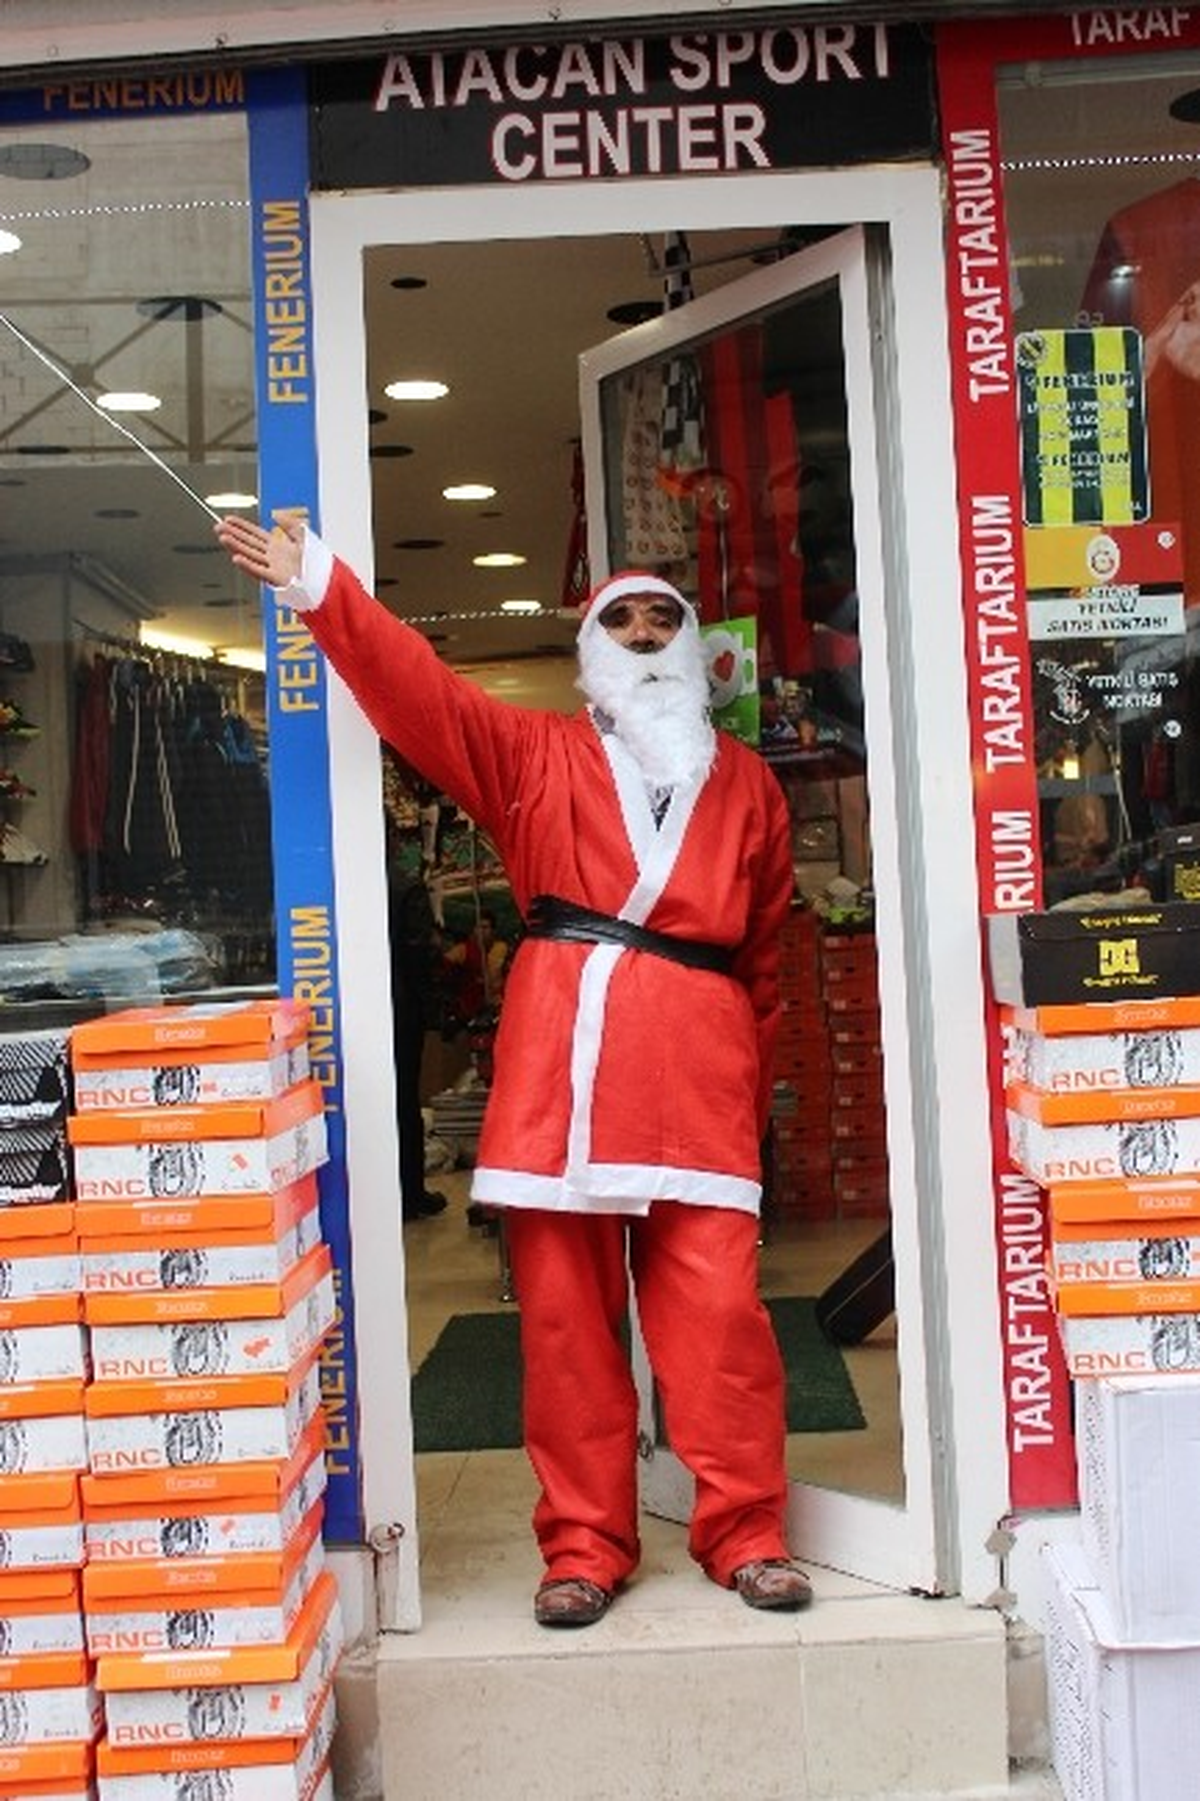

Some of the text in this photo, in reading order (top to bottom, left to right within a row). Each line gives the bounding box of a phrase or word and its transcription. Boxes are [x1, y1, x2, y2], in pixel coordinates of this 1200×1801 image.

[374, 21, 890, 112] ATACAN SPORT
[490, 102, 772, 181] CENTER
[950, 129, 1010, 402] TARAFTARIUM
[263, 201, 308, 404] FENERIUM
[972, 494, 1026, 764] TARAFTARIUM
[1052, 1068, 1120, 1090] RNC
[77, 1087, 149, 1107] RNC
[1044, 1157, 1115, 1178] RNC
[79, 1179, 146, 1197] RNC
[84, 1270, 158, 1289] RNC
[1058, 1259, 1136, 1280] RNC
[1000, 1174, 1055, 1453] TARAFTARIUM
[101, 1358, 168, 1377] RNC
[1073, 1351, 1145, 1370] RNC
[91, 1449, 162, 1470] RNC
[82, 1538, 158, 1558] RNC
[91, 1630, 163, 1650] RNC
[114, 1722, 184, 1741] RNC
